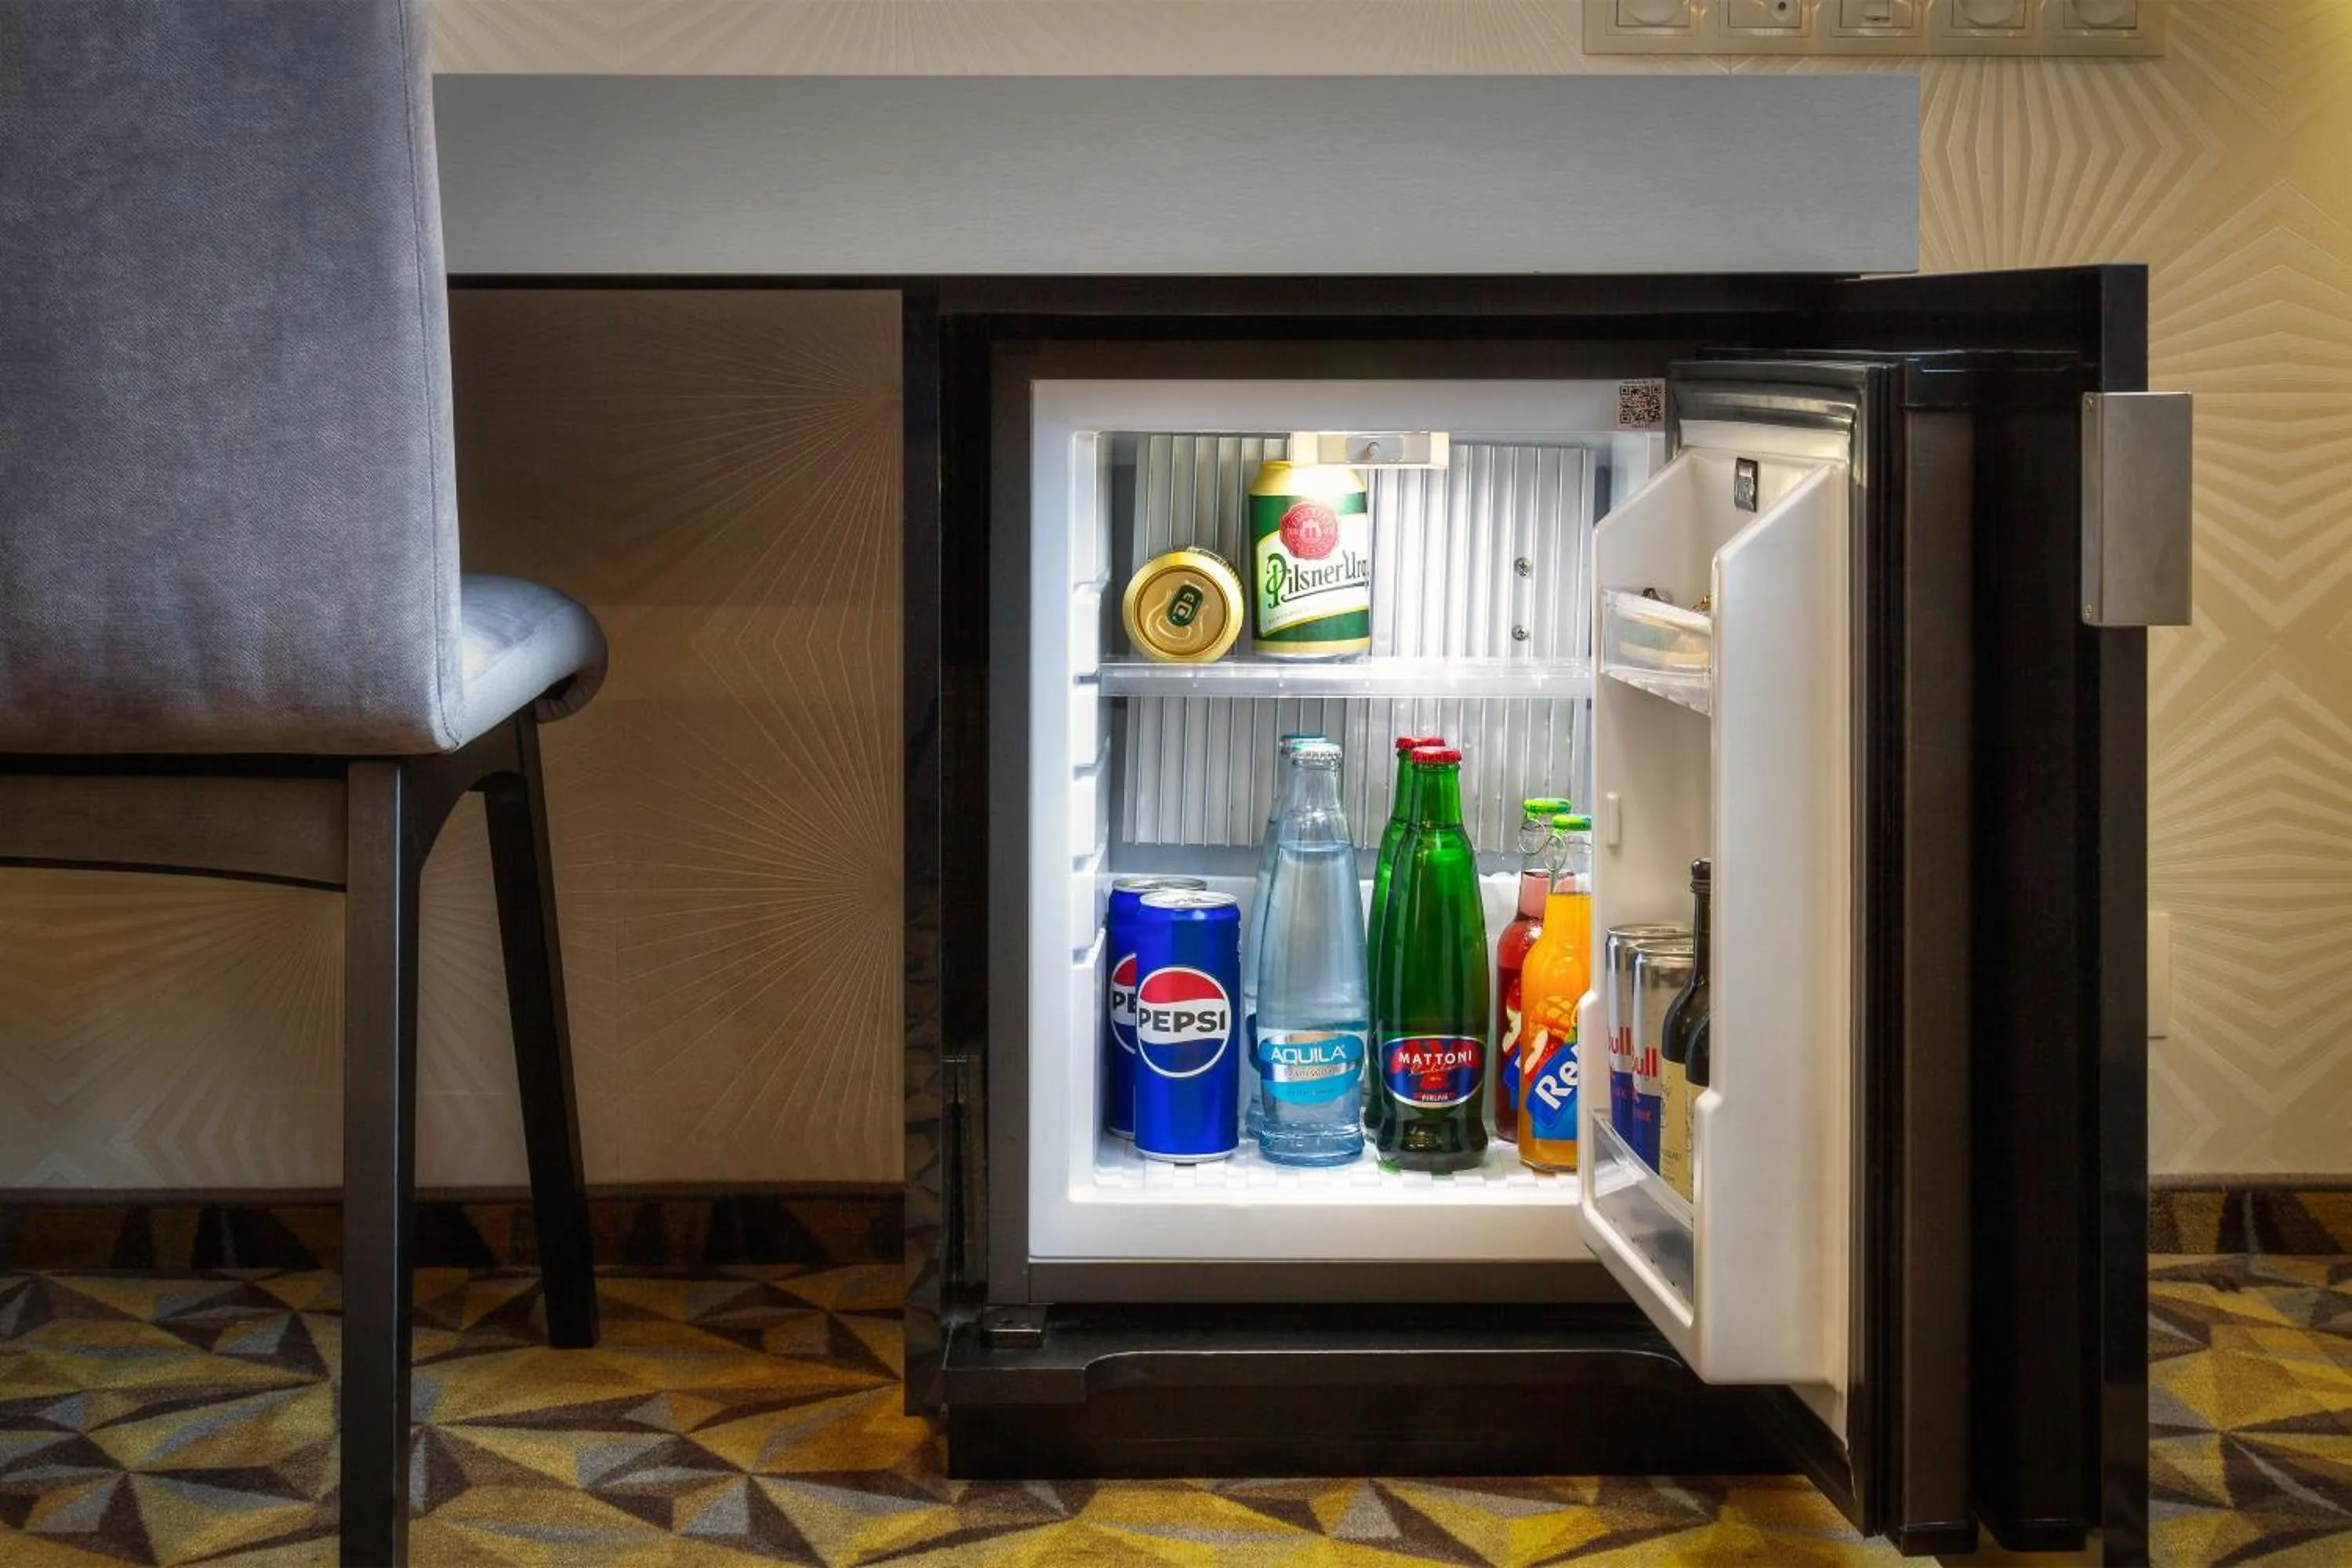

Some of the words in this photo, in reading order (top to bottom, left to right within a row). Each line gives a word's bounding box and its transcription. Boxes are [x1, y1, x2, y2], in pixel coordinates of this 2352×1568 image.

[1265, 553, 1343, 608] Pilsner
[1138, 1007, 1226, 1033] PEPSI
[1270, 1045, 1347, 1065] AQUILA
[1398, 1050, 1472, 1065] MATTONI
